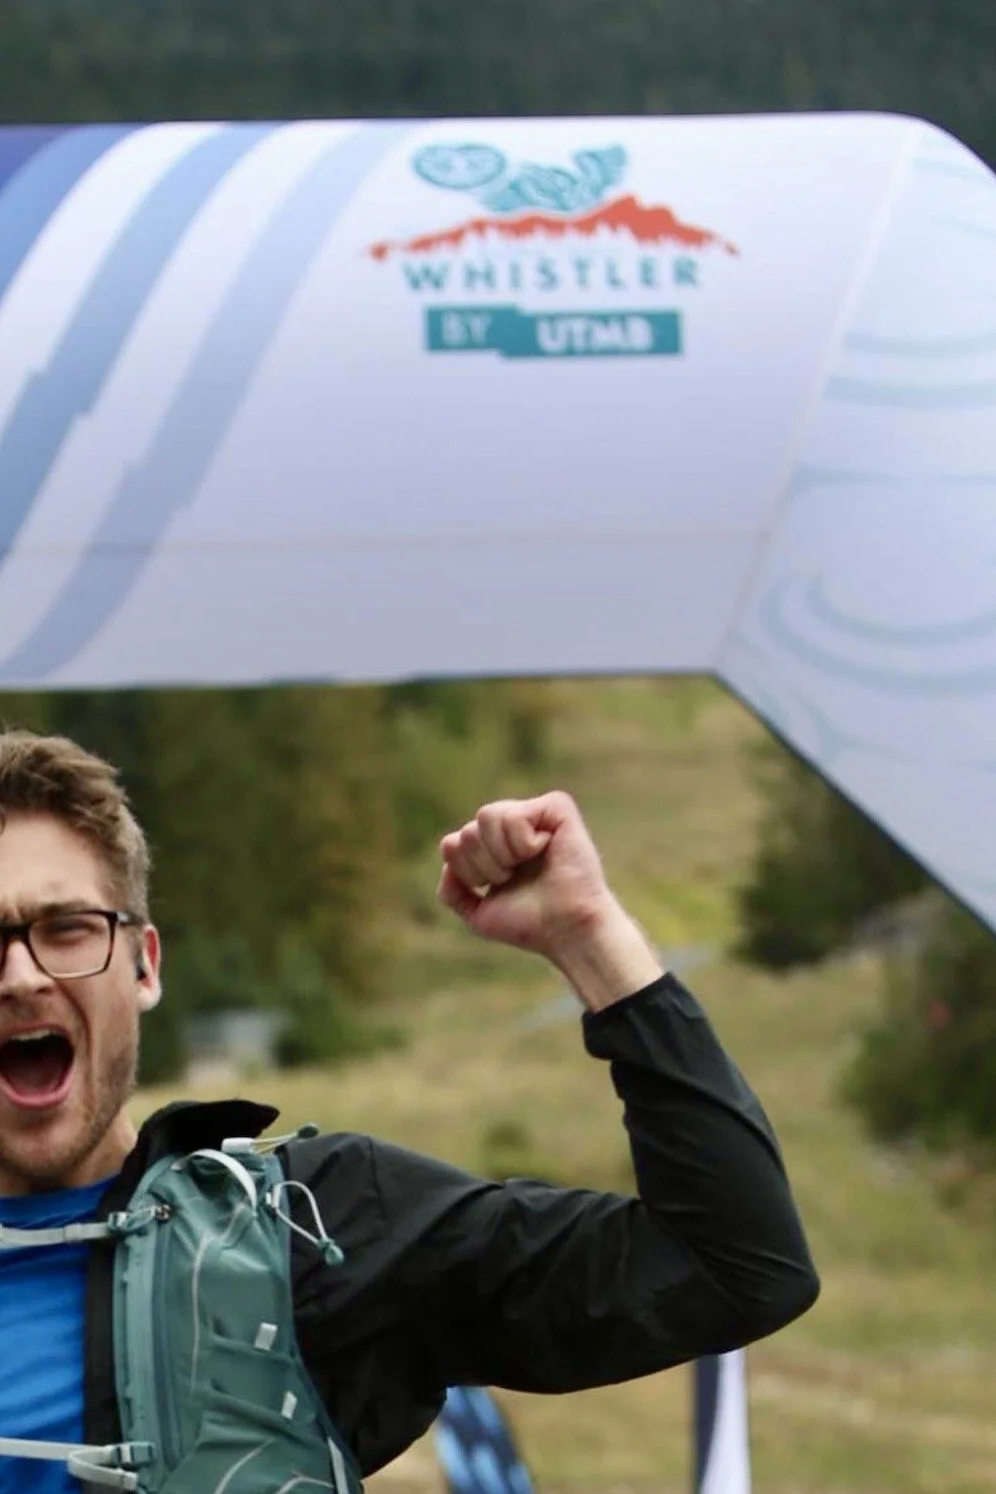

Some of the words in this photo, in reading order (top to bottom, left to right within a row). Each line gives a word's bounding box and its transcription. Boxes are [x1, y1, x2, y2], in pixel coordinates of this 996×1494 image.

[403, 255, 700, 292] WHISTLER
[441, 312, 493, 347] BY
[535, 314, 654, 353] UTMB
